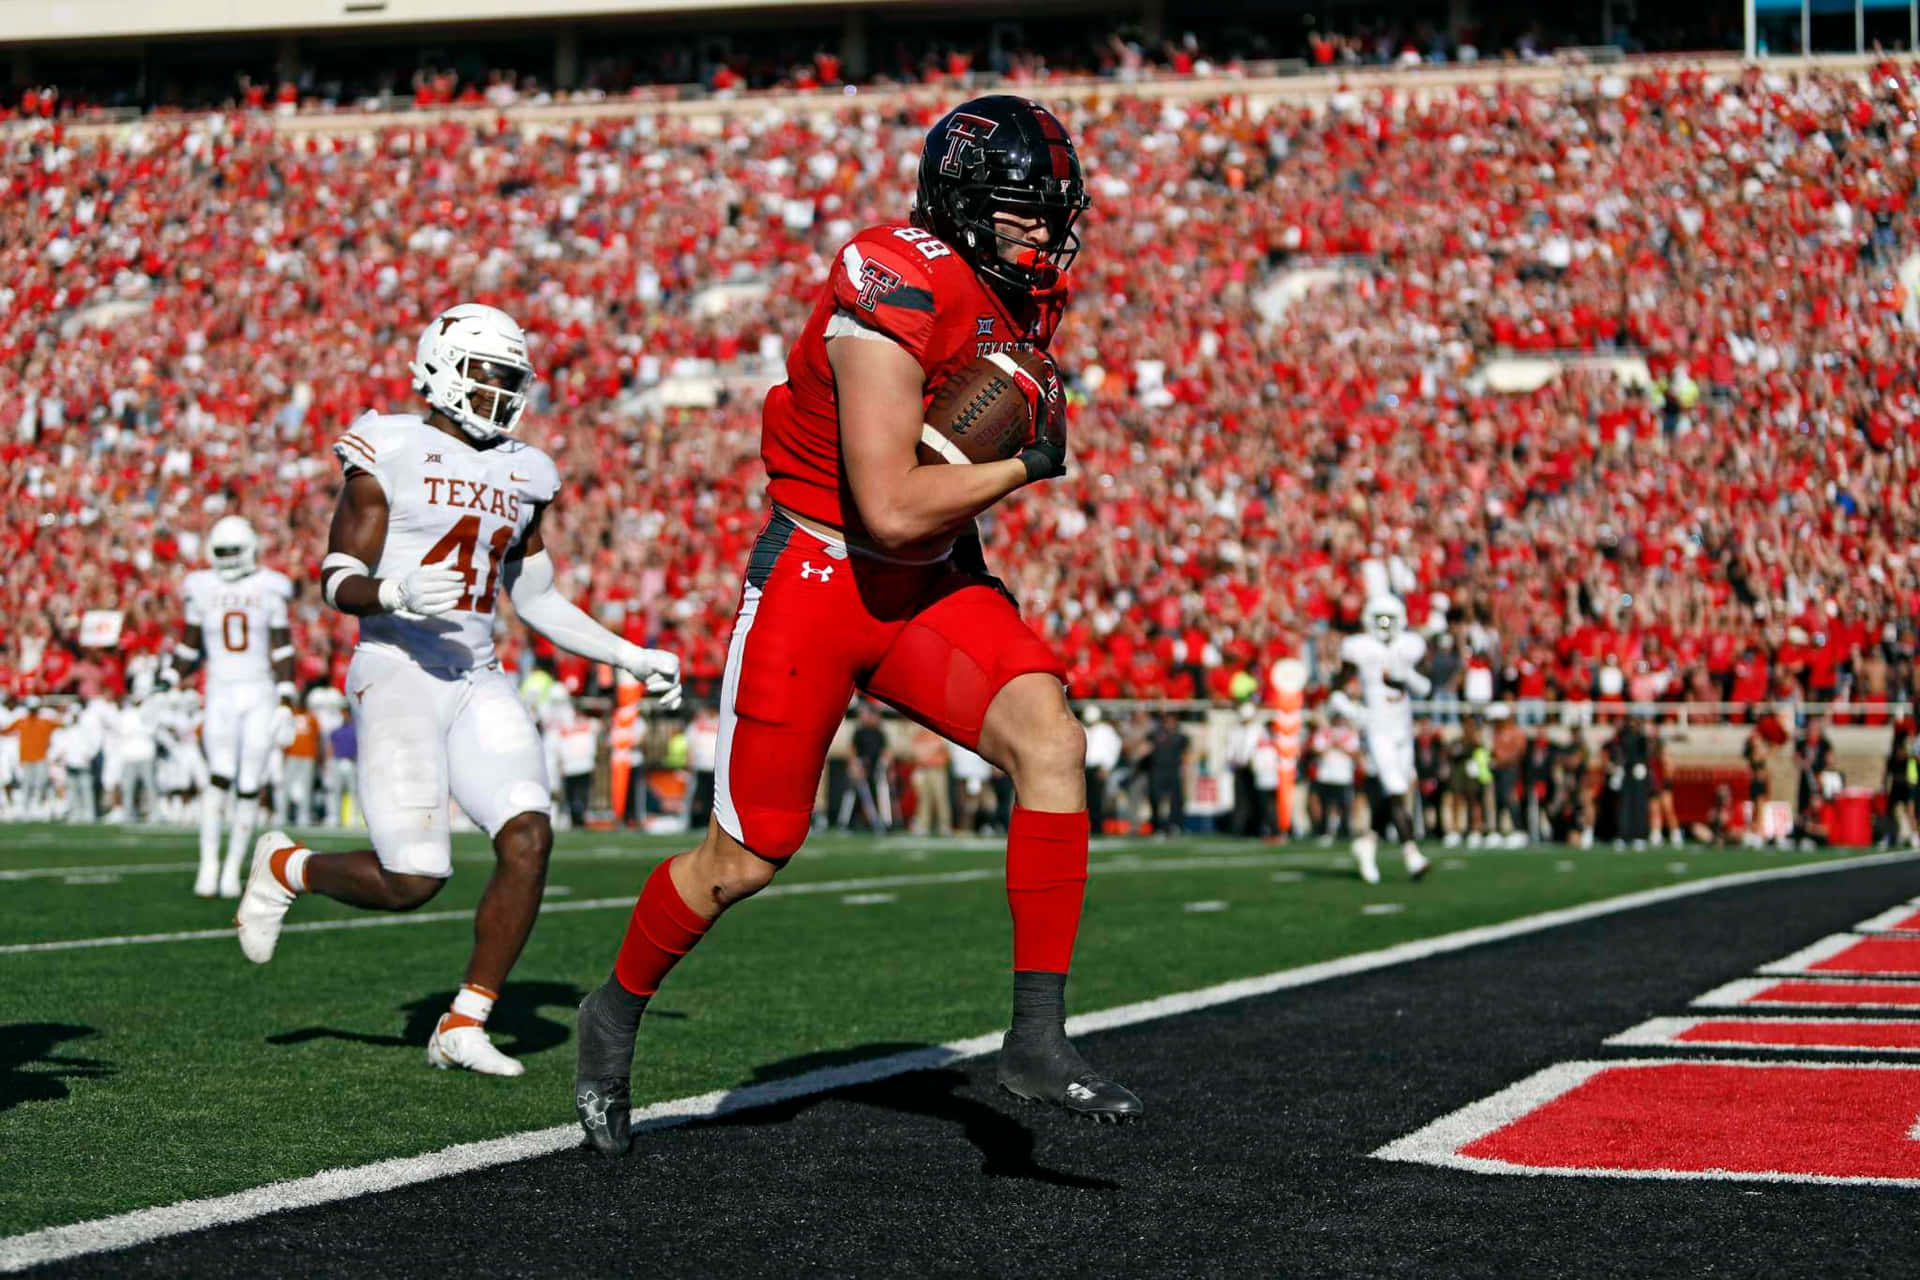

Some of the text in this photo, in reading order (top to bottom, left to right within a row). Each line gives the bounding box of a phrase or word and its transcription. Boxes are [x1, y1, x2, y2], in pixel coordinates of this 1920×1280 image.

[893, 227, 952, 260] 88
[424, 476, 520, 523] TEXAS
[420, 514, 515, 614] 41
[223, 610, 248, 652] 0
